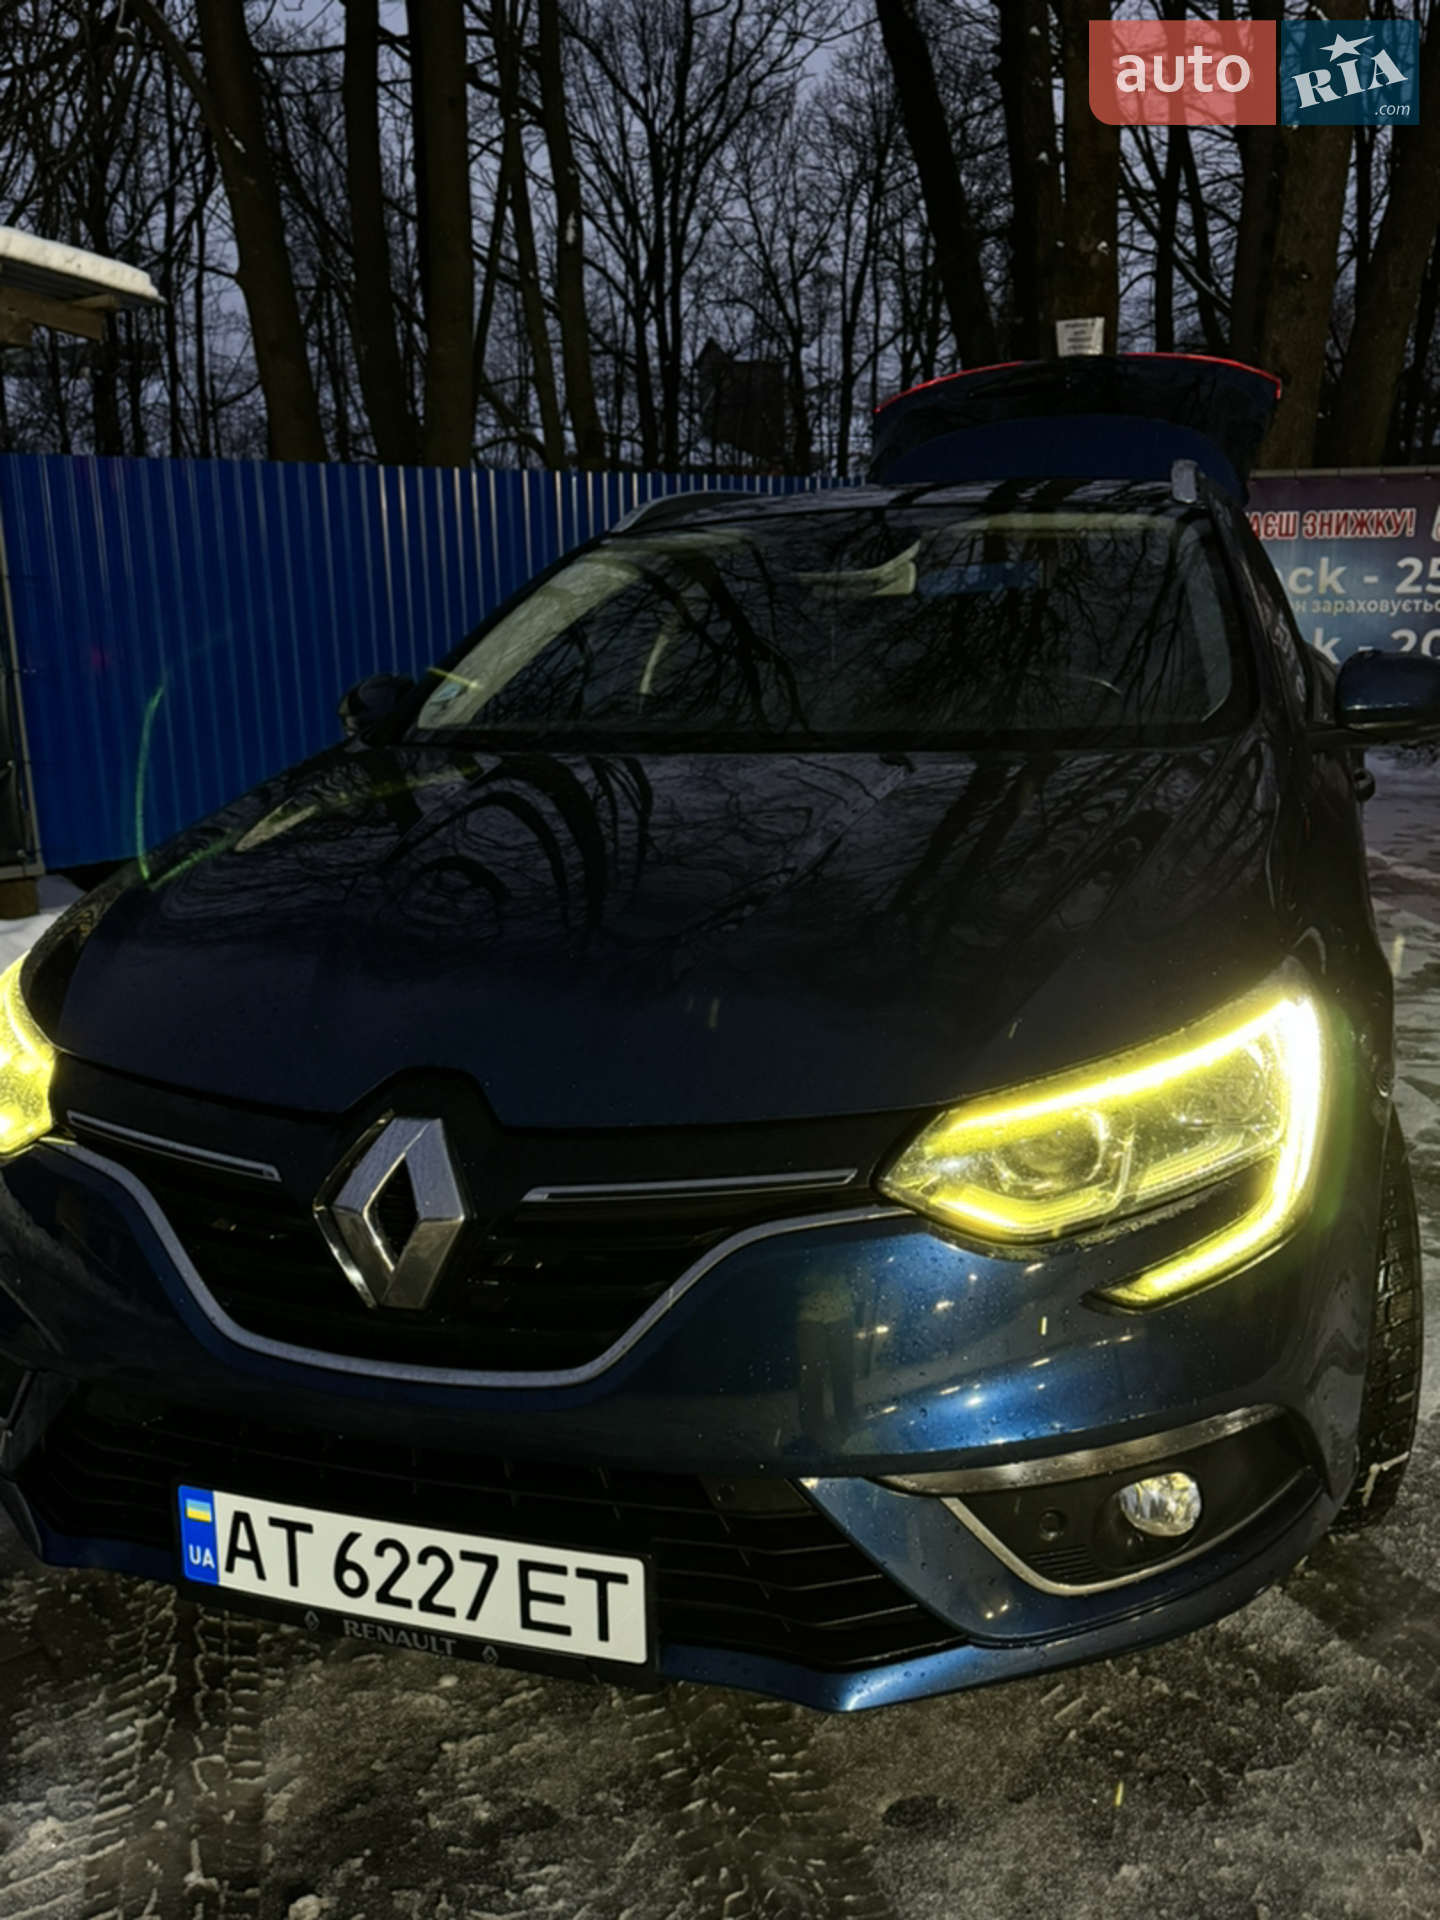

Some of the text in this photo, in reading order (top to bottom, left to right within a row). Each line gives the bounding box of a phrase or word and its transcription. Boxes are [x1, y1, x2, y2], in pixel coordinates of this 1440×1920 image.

[1245, 511, 1299, 540] АЄШ
[1302, 508, 1416, 539] ЗНИЖКУ!
[1275, 557, 1347, 595] ck
[188, 1544, 216, 1569] UA
[225, 1510, 629, 1643] AT 6227 ET
[342, 1618, 458, 1656] RENAULT
